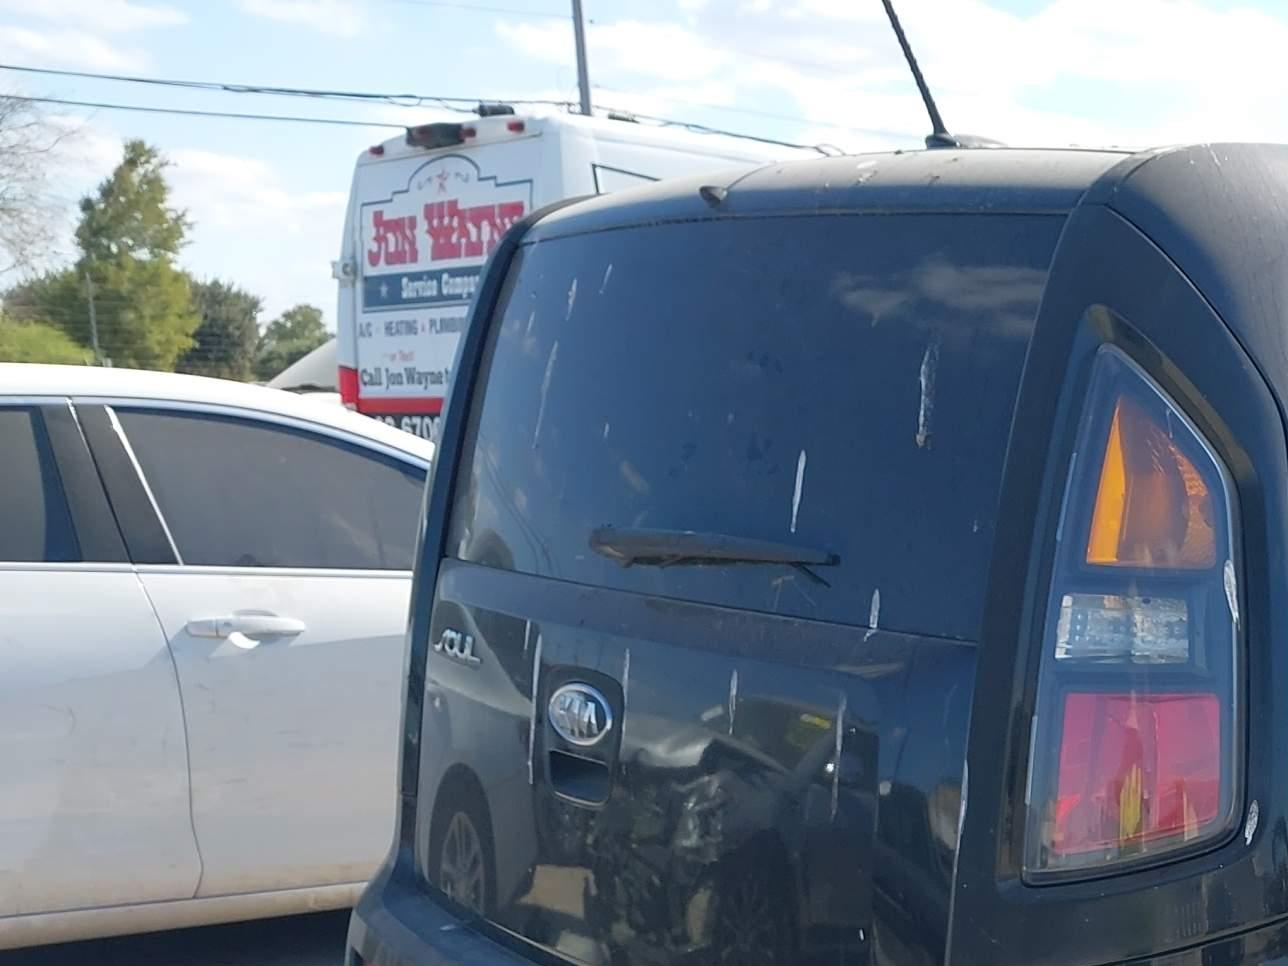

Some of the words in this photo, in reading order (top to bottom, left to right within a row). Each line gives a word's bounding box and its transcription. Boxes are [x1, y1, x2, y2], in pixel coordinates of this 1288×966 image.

[401, 276, 438, 299] Service
[383, 319, 419, 337] HEATING
[360, 367, 382, 387] Call
[385, 367, 403, 390] Jon
[404, 367, 444, 390] Wayne
[554, 688, 603, 741] KIA
